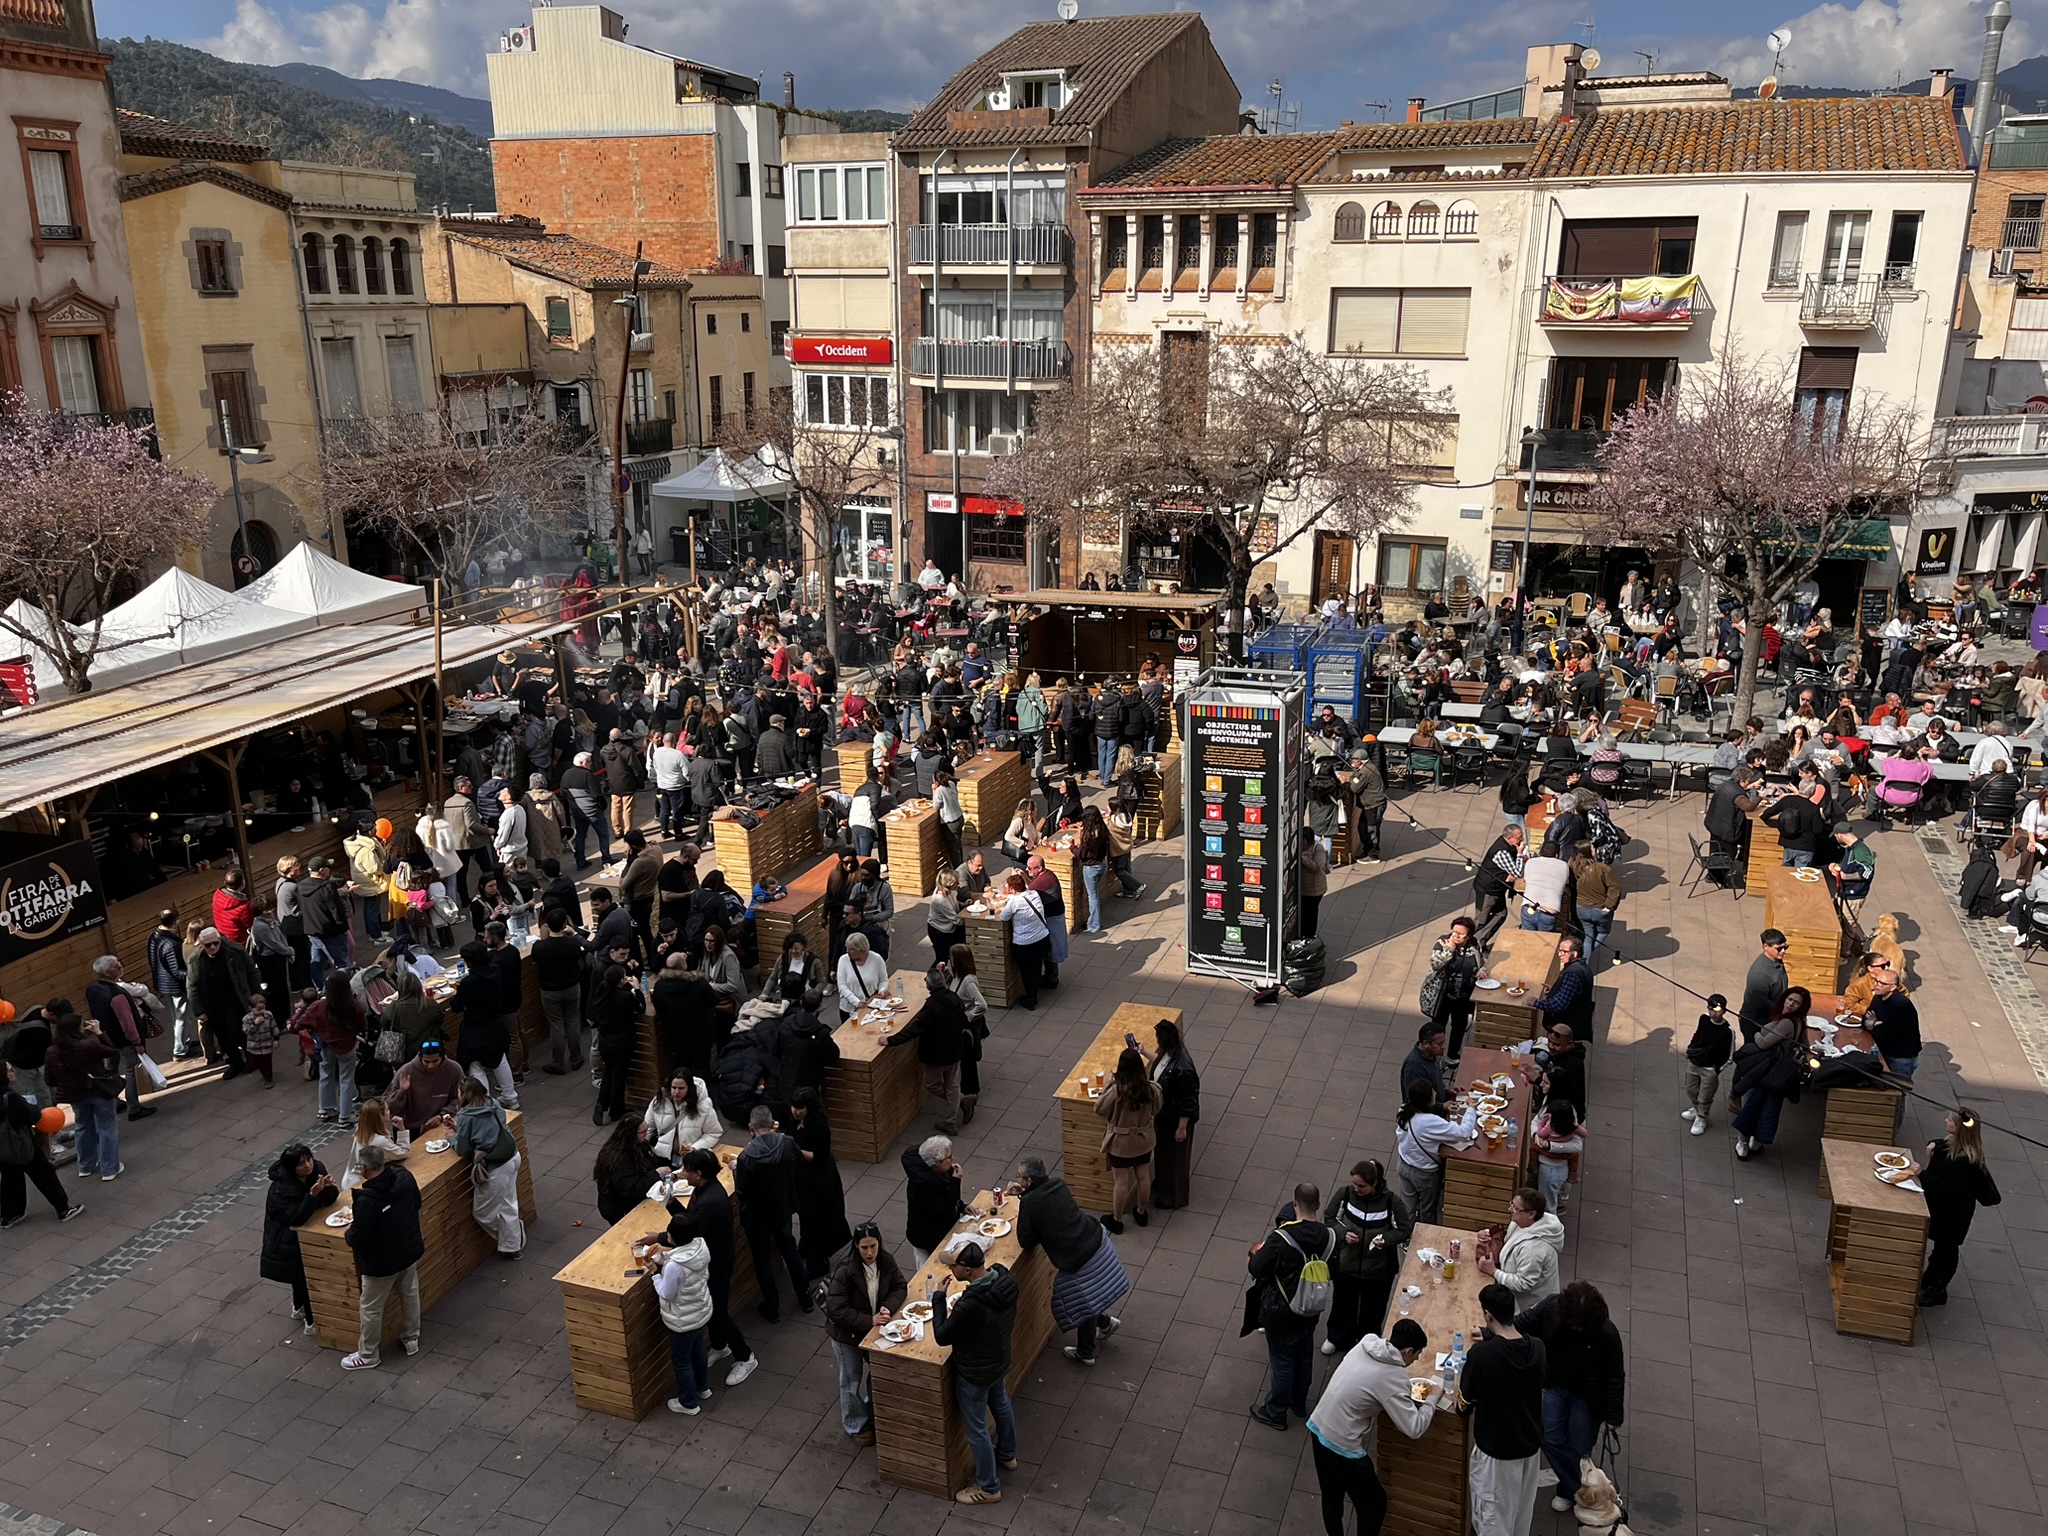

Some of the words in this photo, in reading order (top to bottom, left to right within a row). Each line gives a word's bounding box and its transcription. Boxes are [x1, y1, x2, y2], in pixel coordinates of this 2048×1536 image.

[825, 344, 867, 356] Occident
[1197, 727, 1273, 739] DESENVOLUPAMENT
[1210, 735, 1259, 745] SOSTENIBLE
[8, 880, 50, 906] FIRA
[48, 874, 60, 883] DE
[50, 882, 61, 890] LA
[7, 922, 23, 935] LA
[24, 901, 75, 928] GARRIGA
